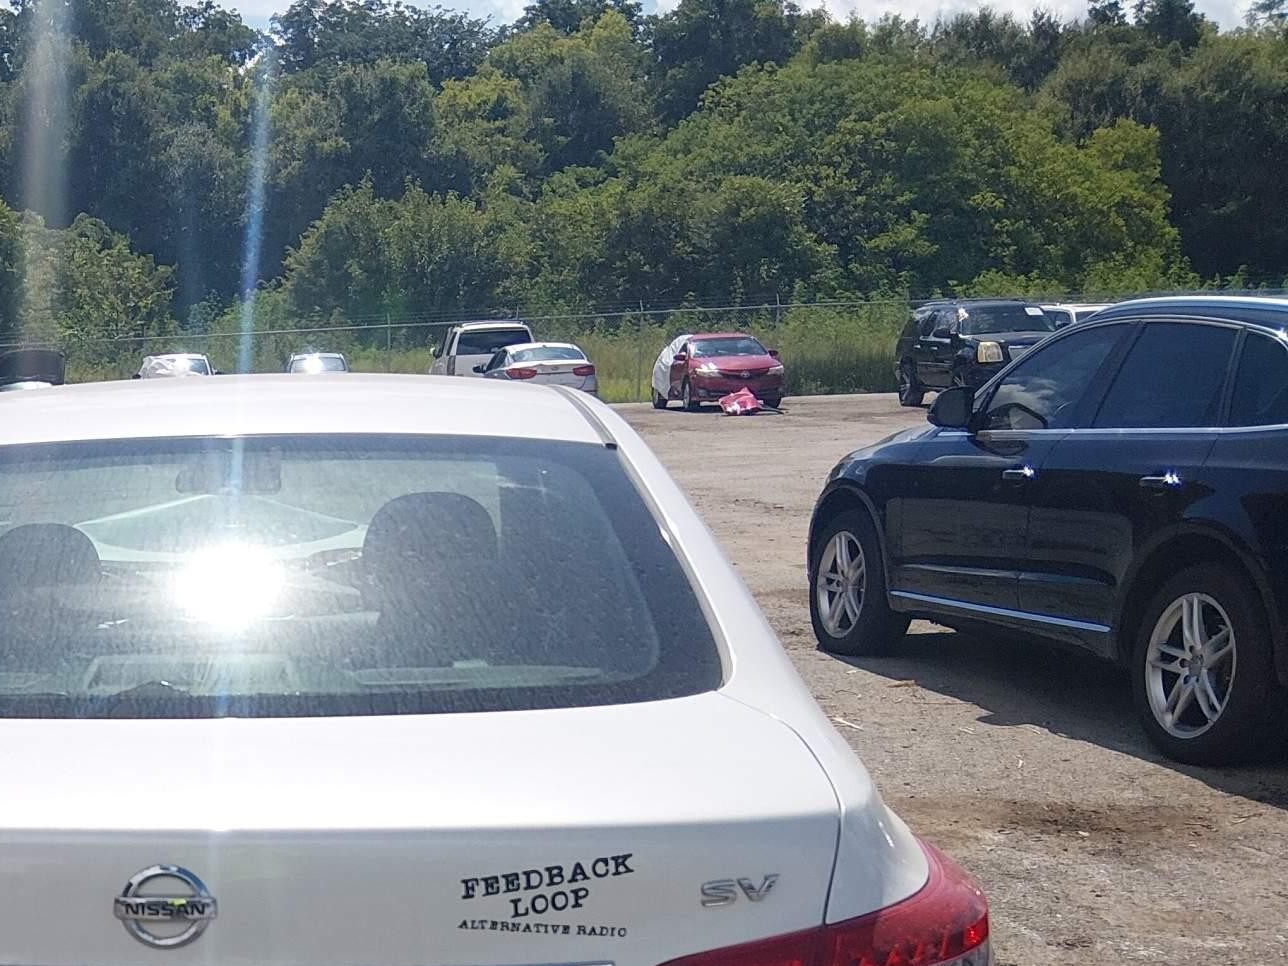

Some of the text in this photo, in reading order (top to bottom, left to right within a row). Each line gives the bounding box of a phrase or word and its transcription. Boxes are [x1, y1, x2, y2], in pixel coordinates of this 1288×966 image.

[461, 853, 634, 900] FEEDBACK
[700, 873, 780, 908] SV
[124, 902, 206, 917] NISSAN
[509, 887, 589, 918] LOOP
[458, 919, 628, 938] ALTERNATIVE RADIO
